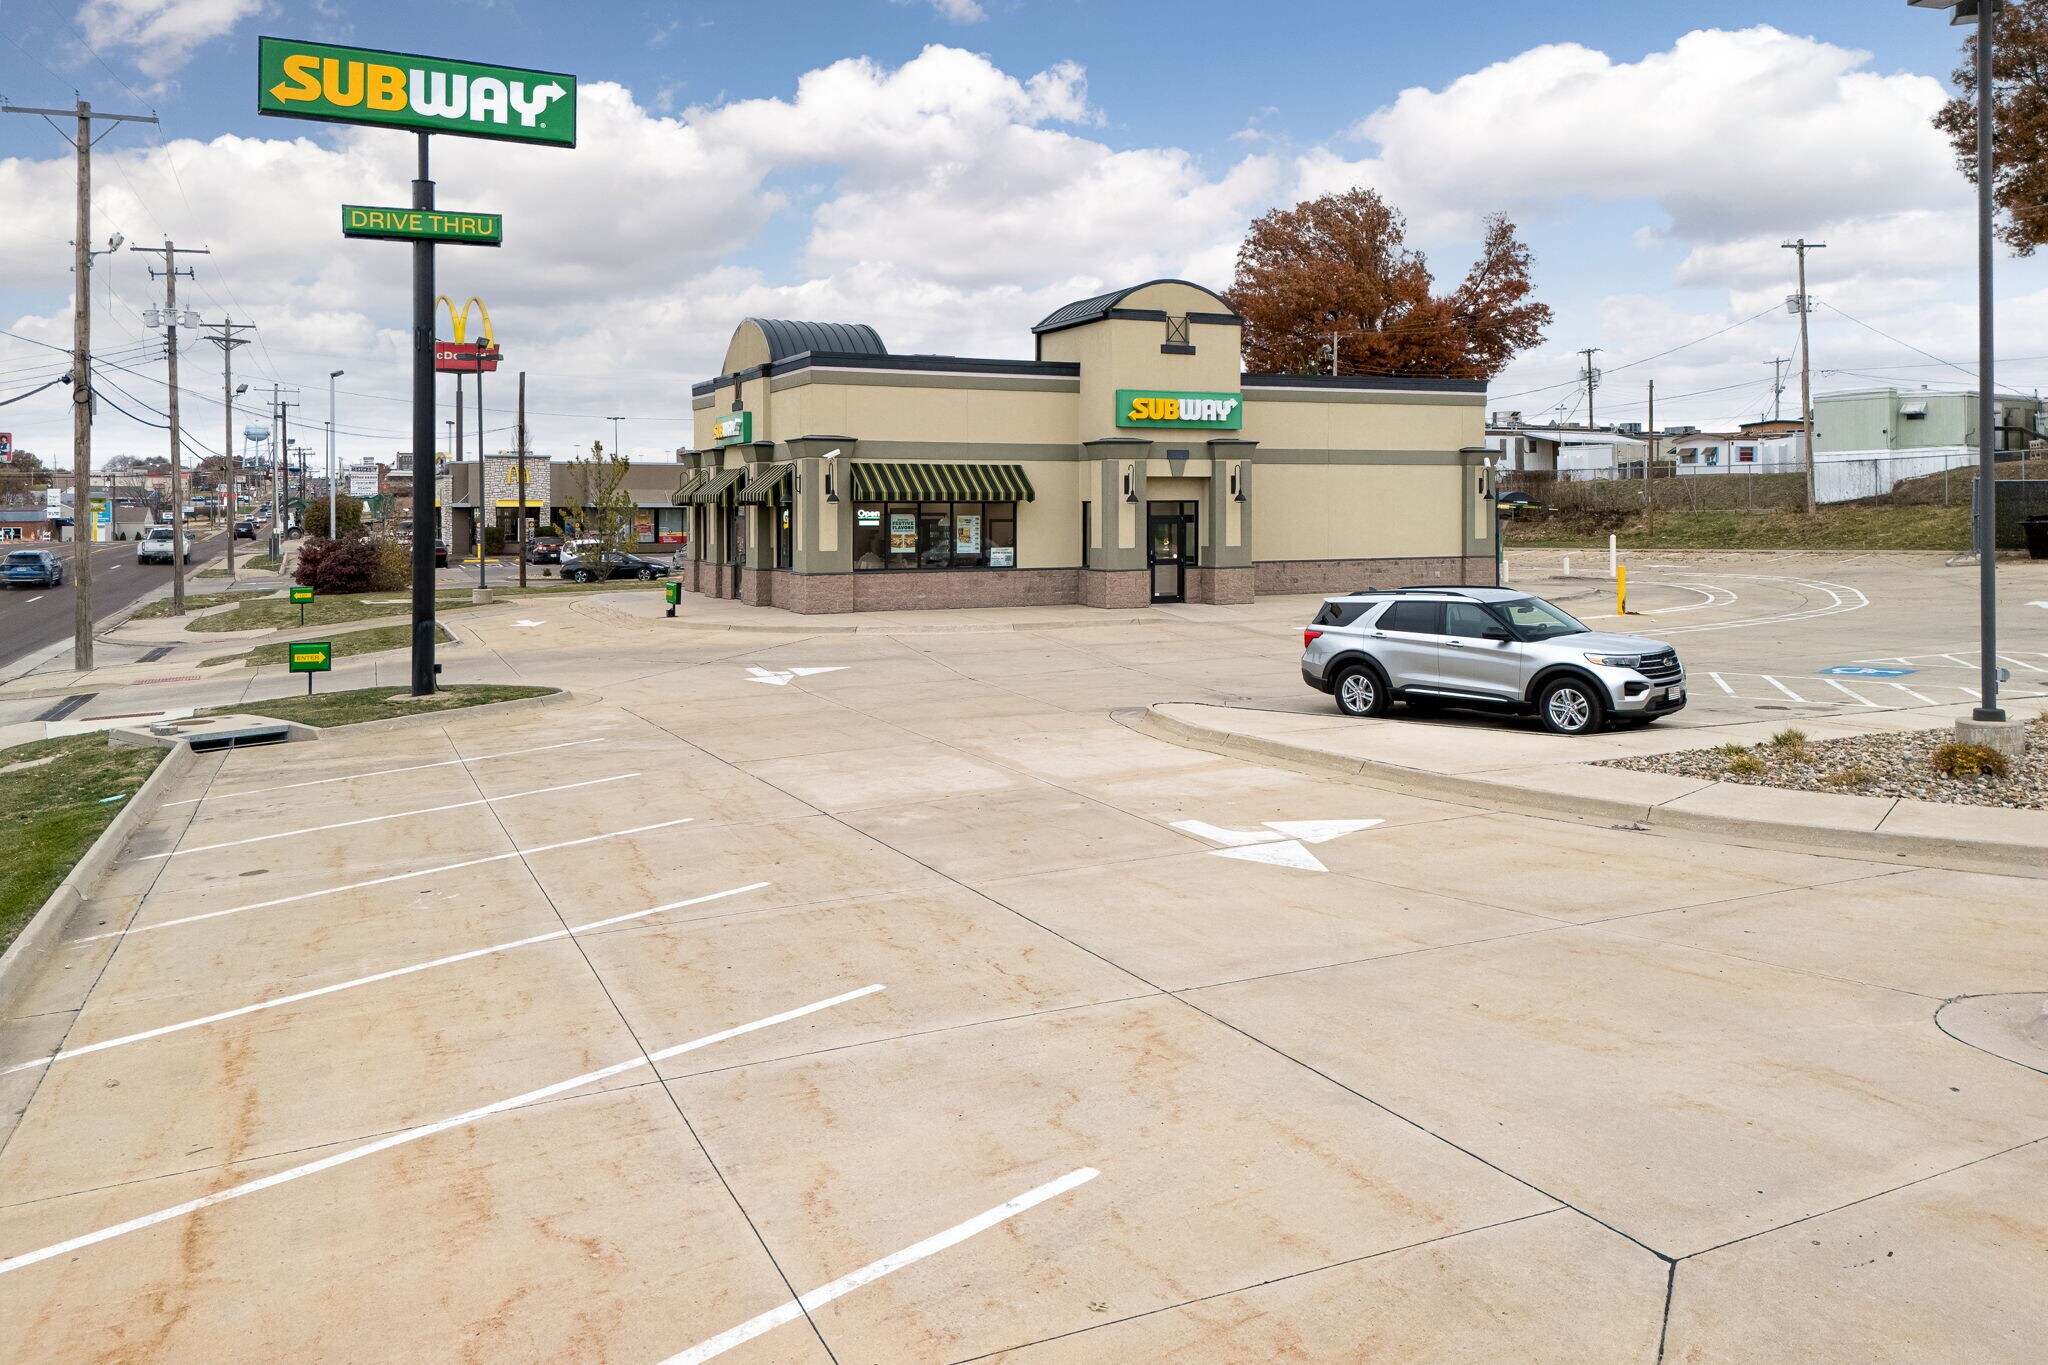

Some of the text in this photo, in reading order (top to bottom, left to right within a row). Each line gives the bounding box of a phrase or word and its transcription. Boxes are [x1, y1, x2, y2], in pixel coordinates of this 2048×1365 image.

[352, 211, 493, 235] DRIVE THRU
[1128, 397, 1239, 421] SUBWAY
[857, 509, 881, 518] Open
